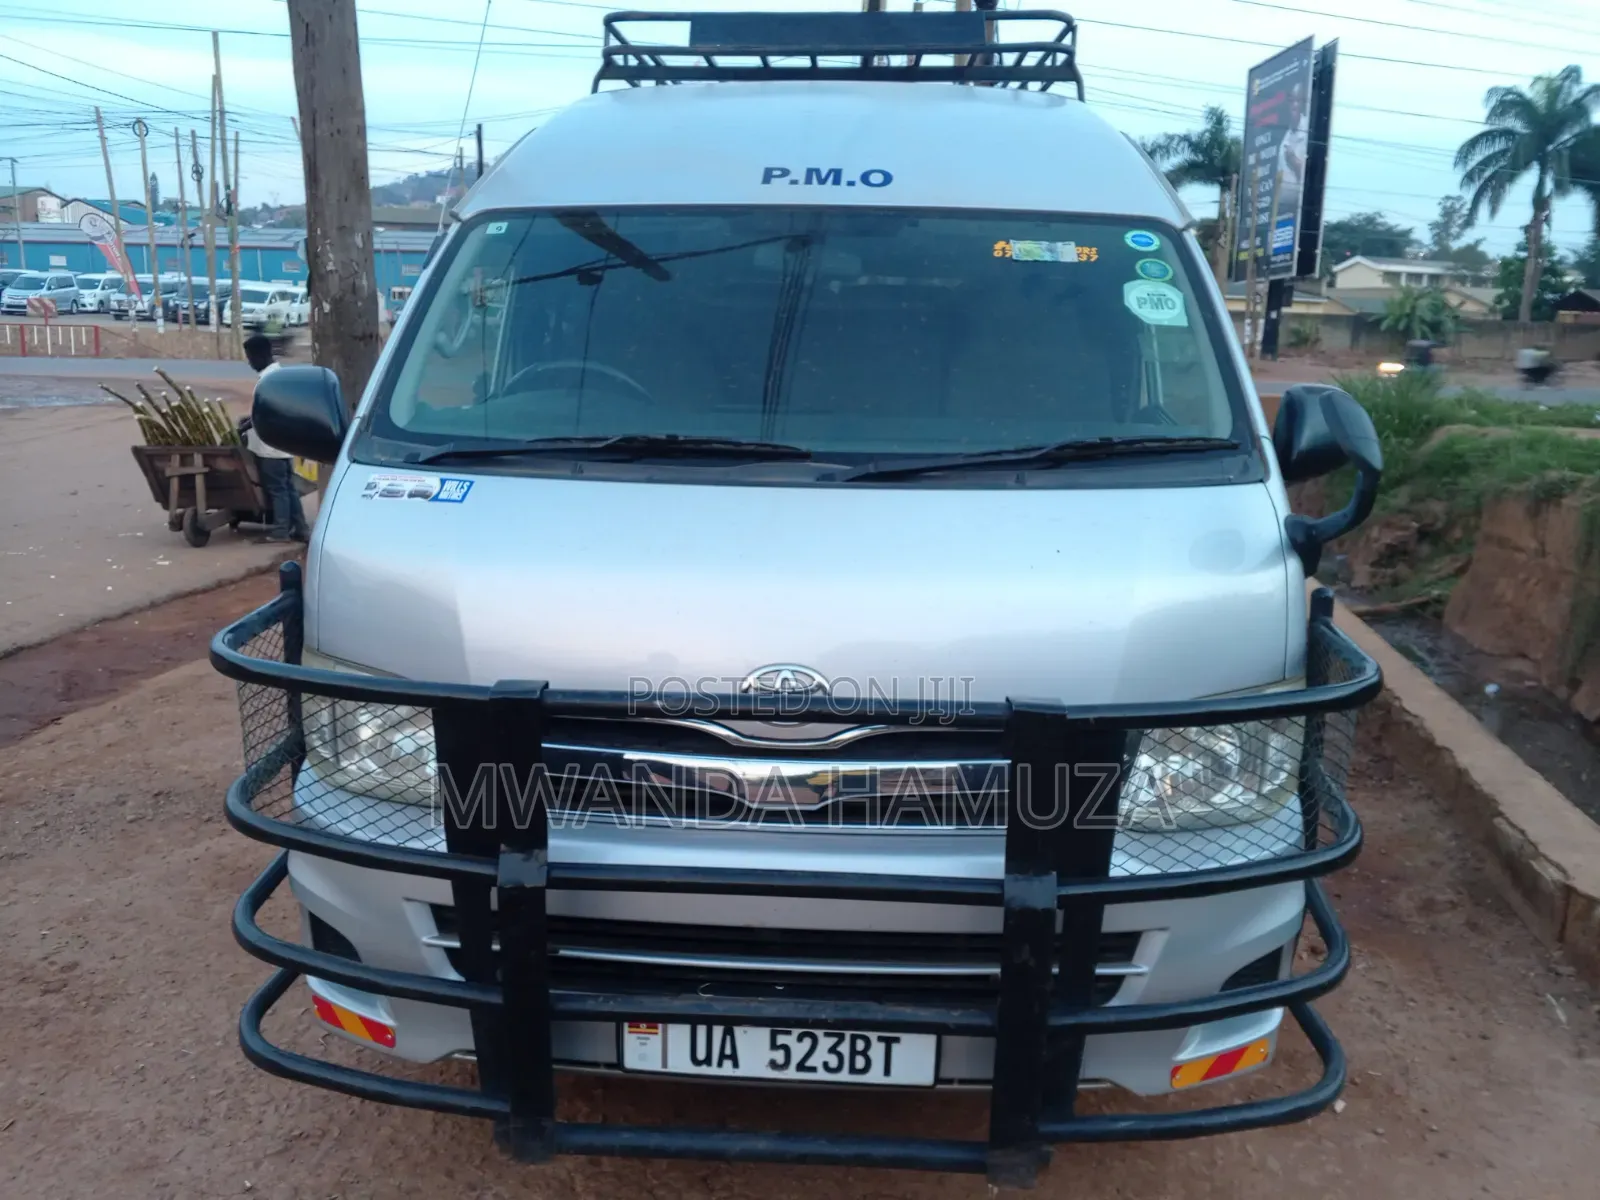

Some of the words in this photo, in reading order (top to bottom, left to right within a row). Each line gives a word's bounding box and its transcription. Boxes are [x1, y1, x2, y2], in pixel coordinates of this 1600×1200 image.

[761, 166, 894, 188] P.M.O
[1135, 295, 1176, 311] PMO
[689, 1023, 740, 1070] UA
[767, 1028, 902, 1078] 523BT
